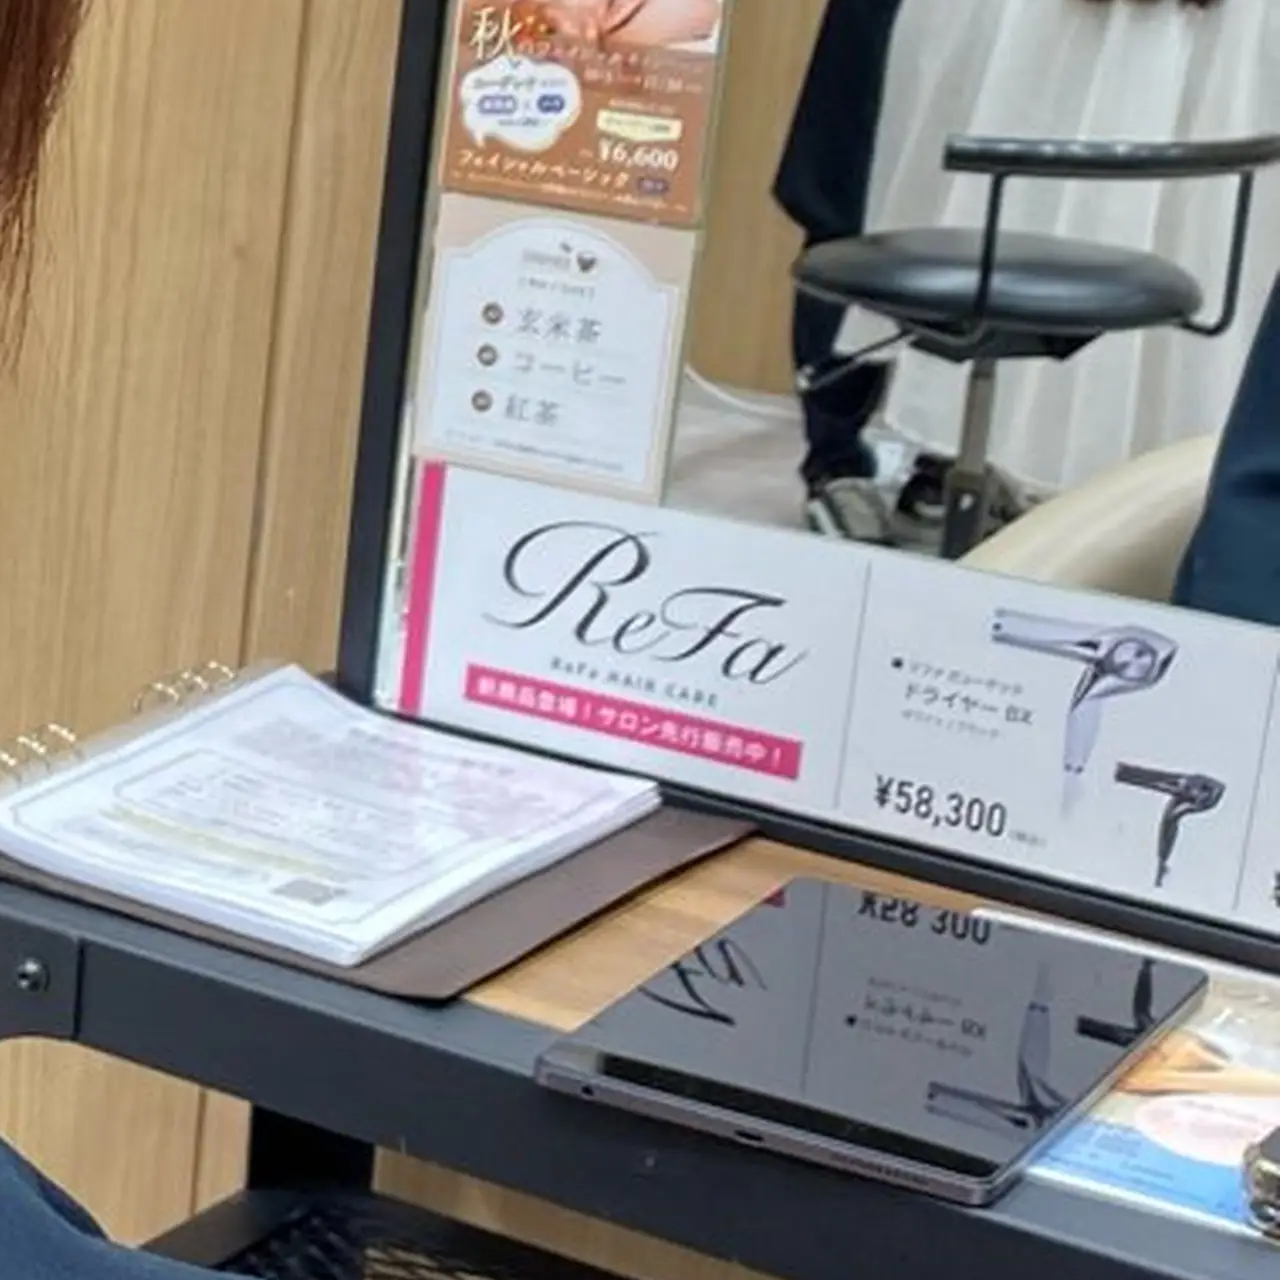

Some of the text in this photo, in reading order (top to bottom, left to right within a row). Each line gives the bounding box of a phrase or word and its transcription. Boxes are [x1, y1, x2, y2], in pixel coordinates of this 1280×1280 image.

[515, 351, 627, 386] コーヒー
[481, 520, 812, 686] ReFa
[606, 669, 657, 694] HAIR
[666, 681, 719, 710] CARE
[904, 682, 999, 716] ドライヤー
[873, 773, 1008, 838] ¥58,300
